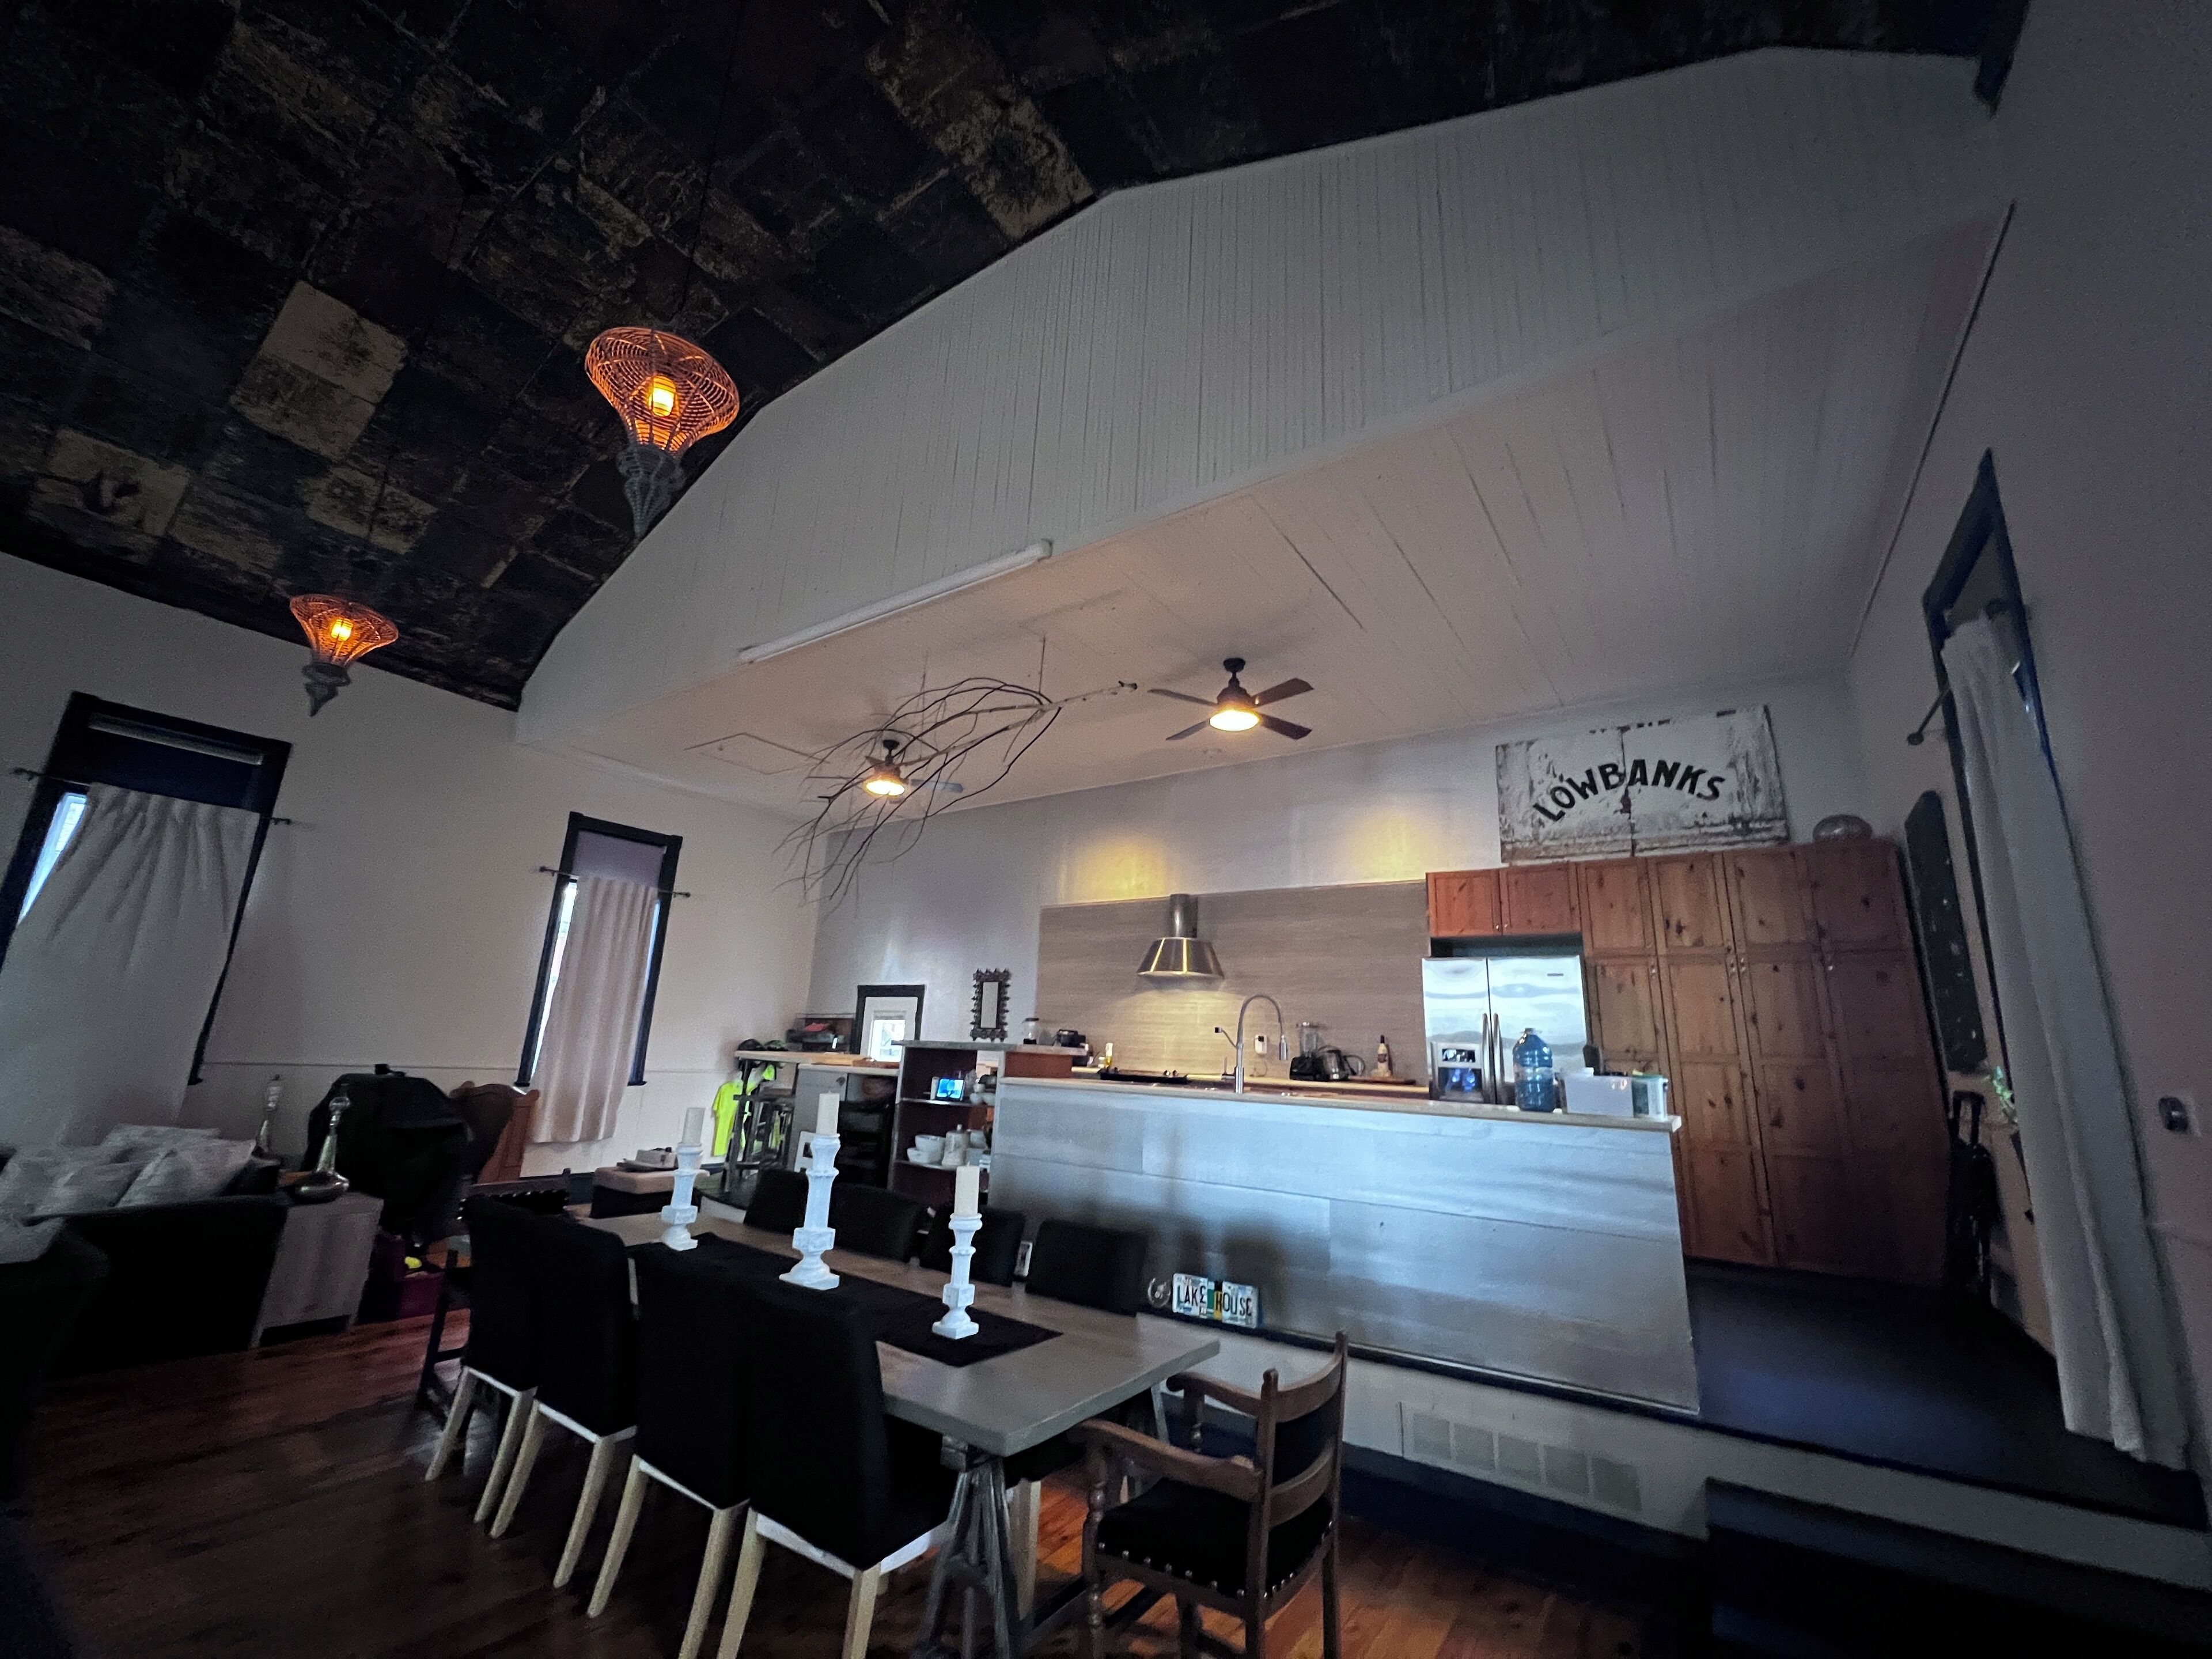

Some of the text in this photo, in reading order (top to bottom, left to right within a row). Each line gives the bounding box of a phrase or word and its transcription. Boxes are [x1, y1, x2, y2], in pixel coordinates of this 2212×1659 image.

[1532, 759, 1725, 822] LOWBANKS
[1177, 1285, 1252, 1317] LAKE HOUSE
